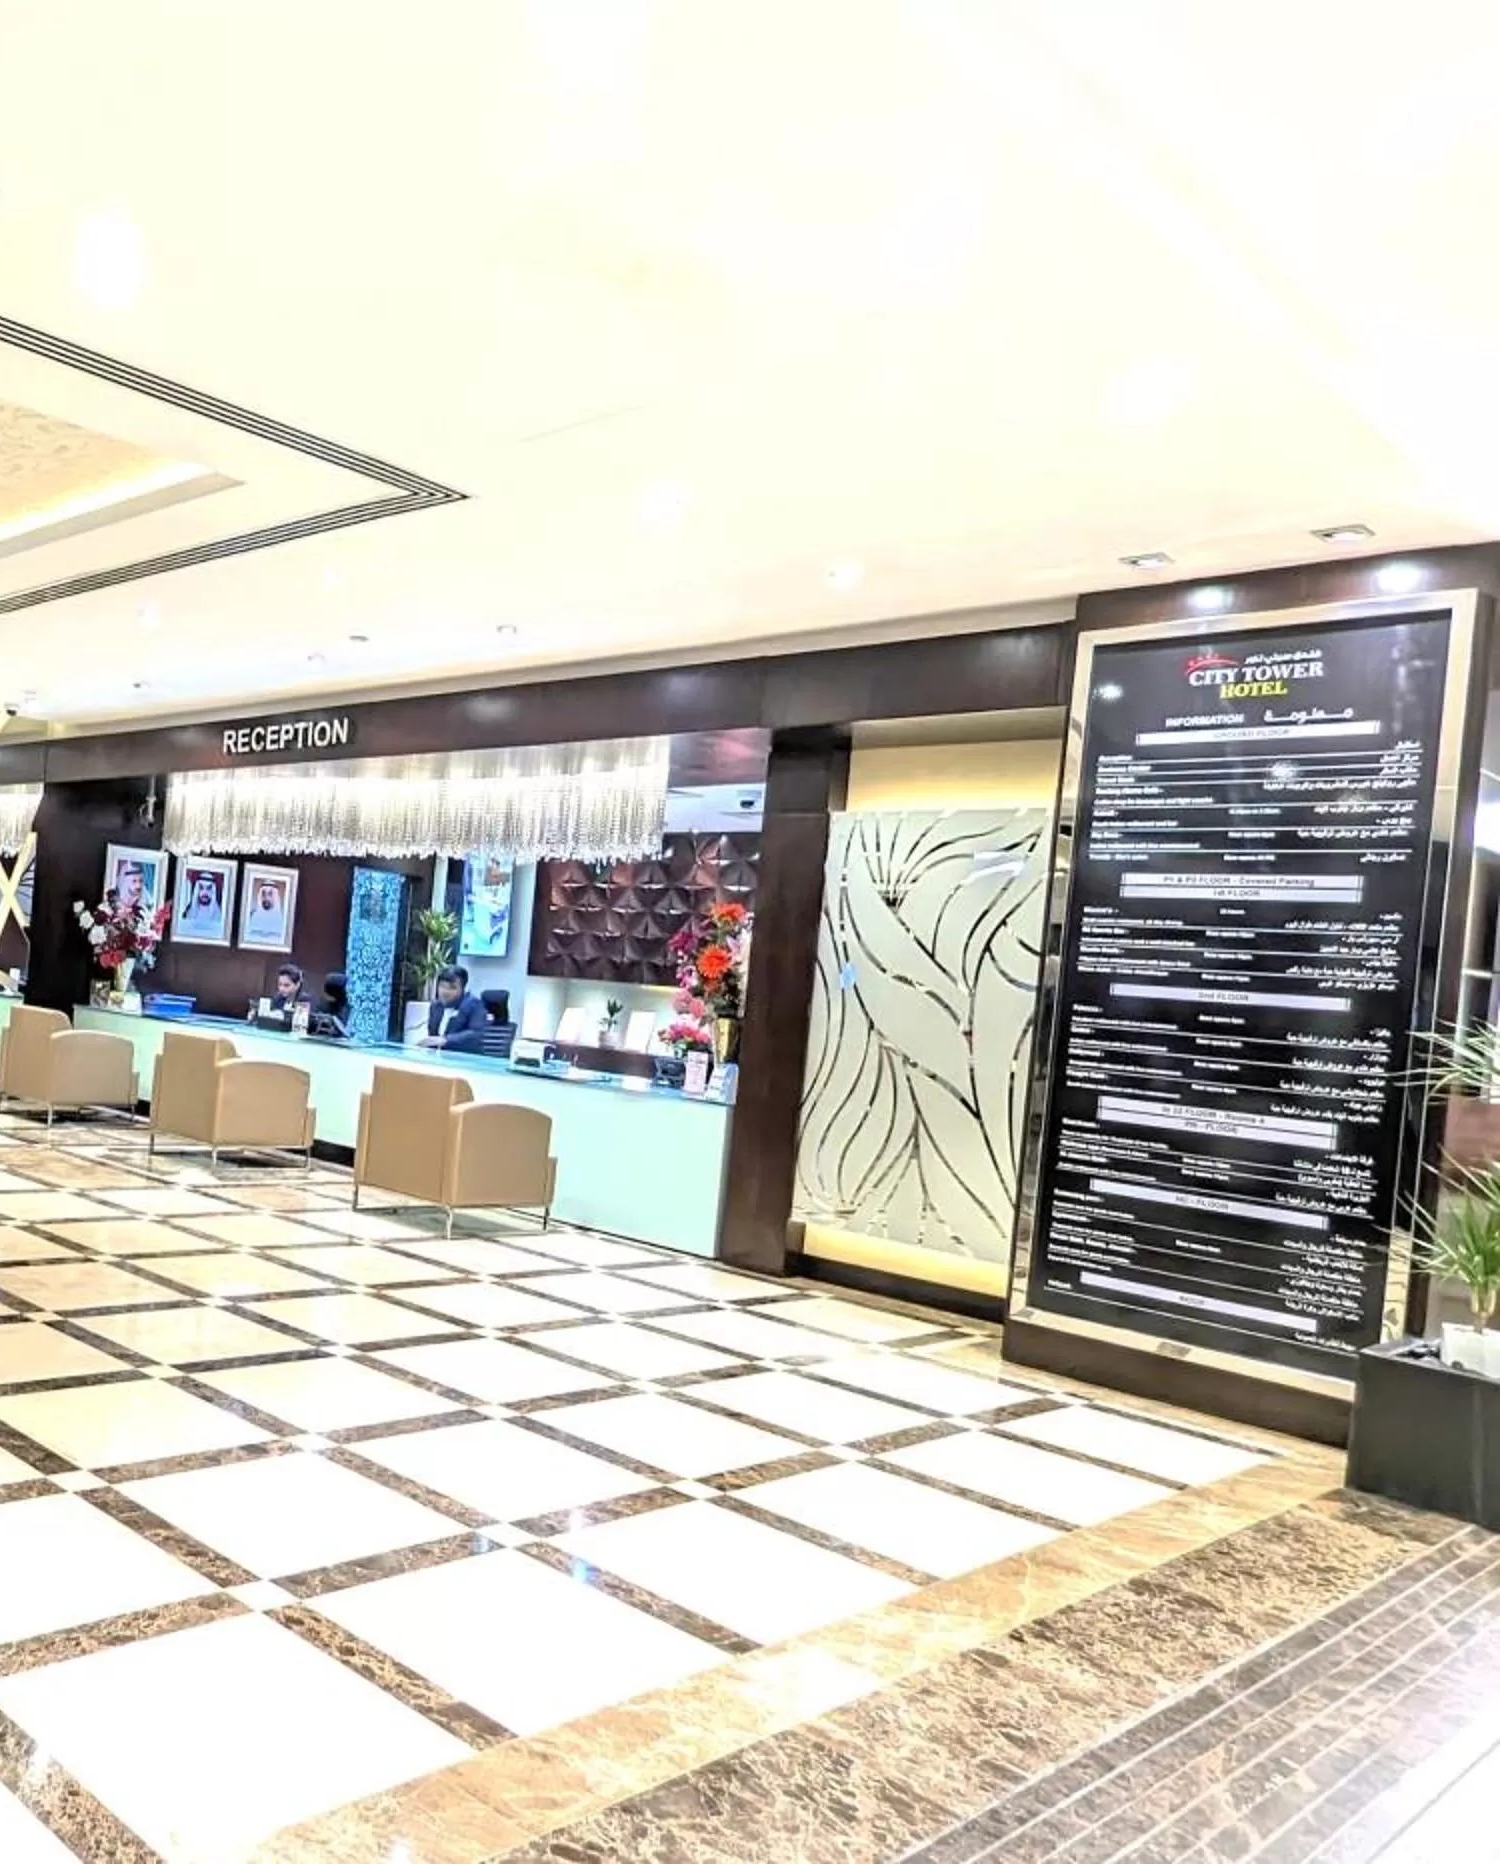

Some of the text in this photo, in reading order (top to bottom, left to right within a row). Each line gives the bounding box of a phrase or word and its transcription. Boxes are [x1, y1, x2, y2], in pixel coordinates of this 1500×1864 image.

[1189, 661, 1324, 687] CITY TOWER
[1219, 681, 1288, 699] HOTEL
[1165, 713, 1245, 728] INFORMATION
[223, 717, 349, 753] RECEPTION
